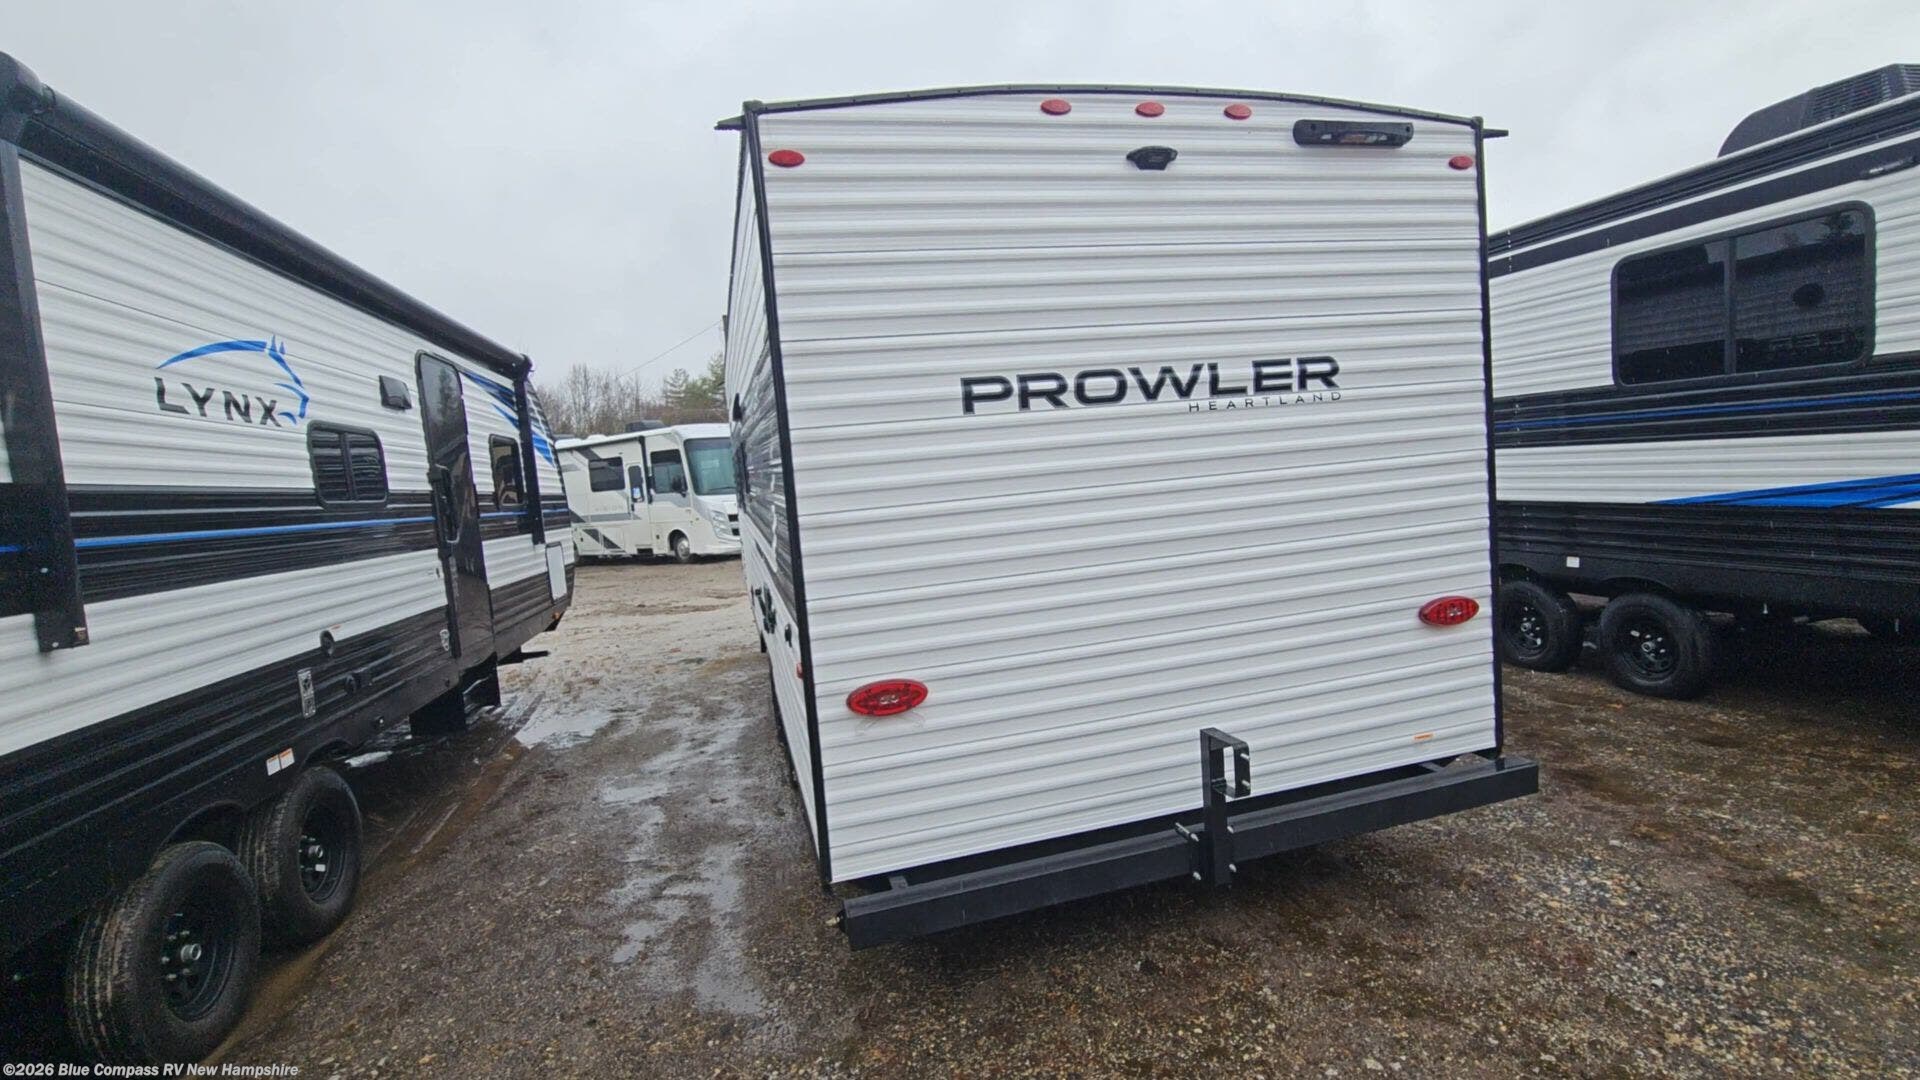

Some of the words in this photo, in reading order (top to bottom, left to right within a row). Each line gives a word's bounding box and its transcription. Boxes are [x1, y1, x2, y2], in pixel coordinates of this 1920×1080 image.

[154, 376, 282, 427] LYNX
[960, 356, 1340, 415] PROWLER
[1188, 391, 1342, 413] HEARTLAND
